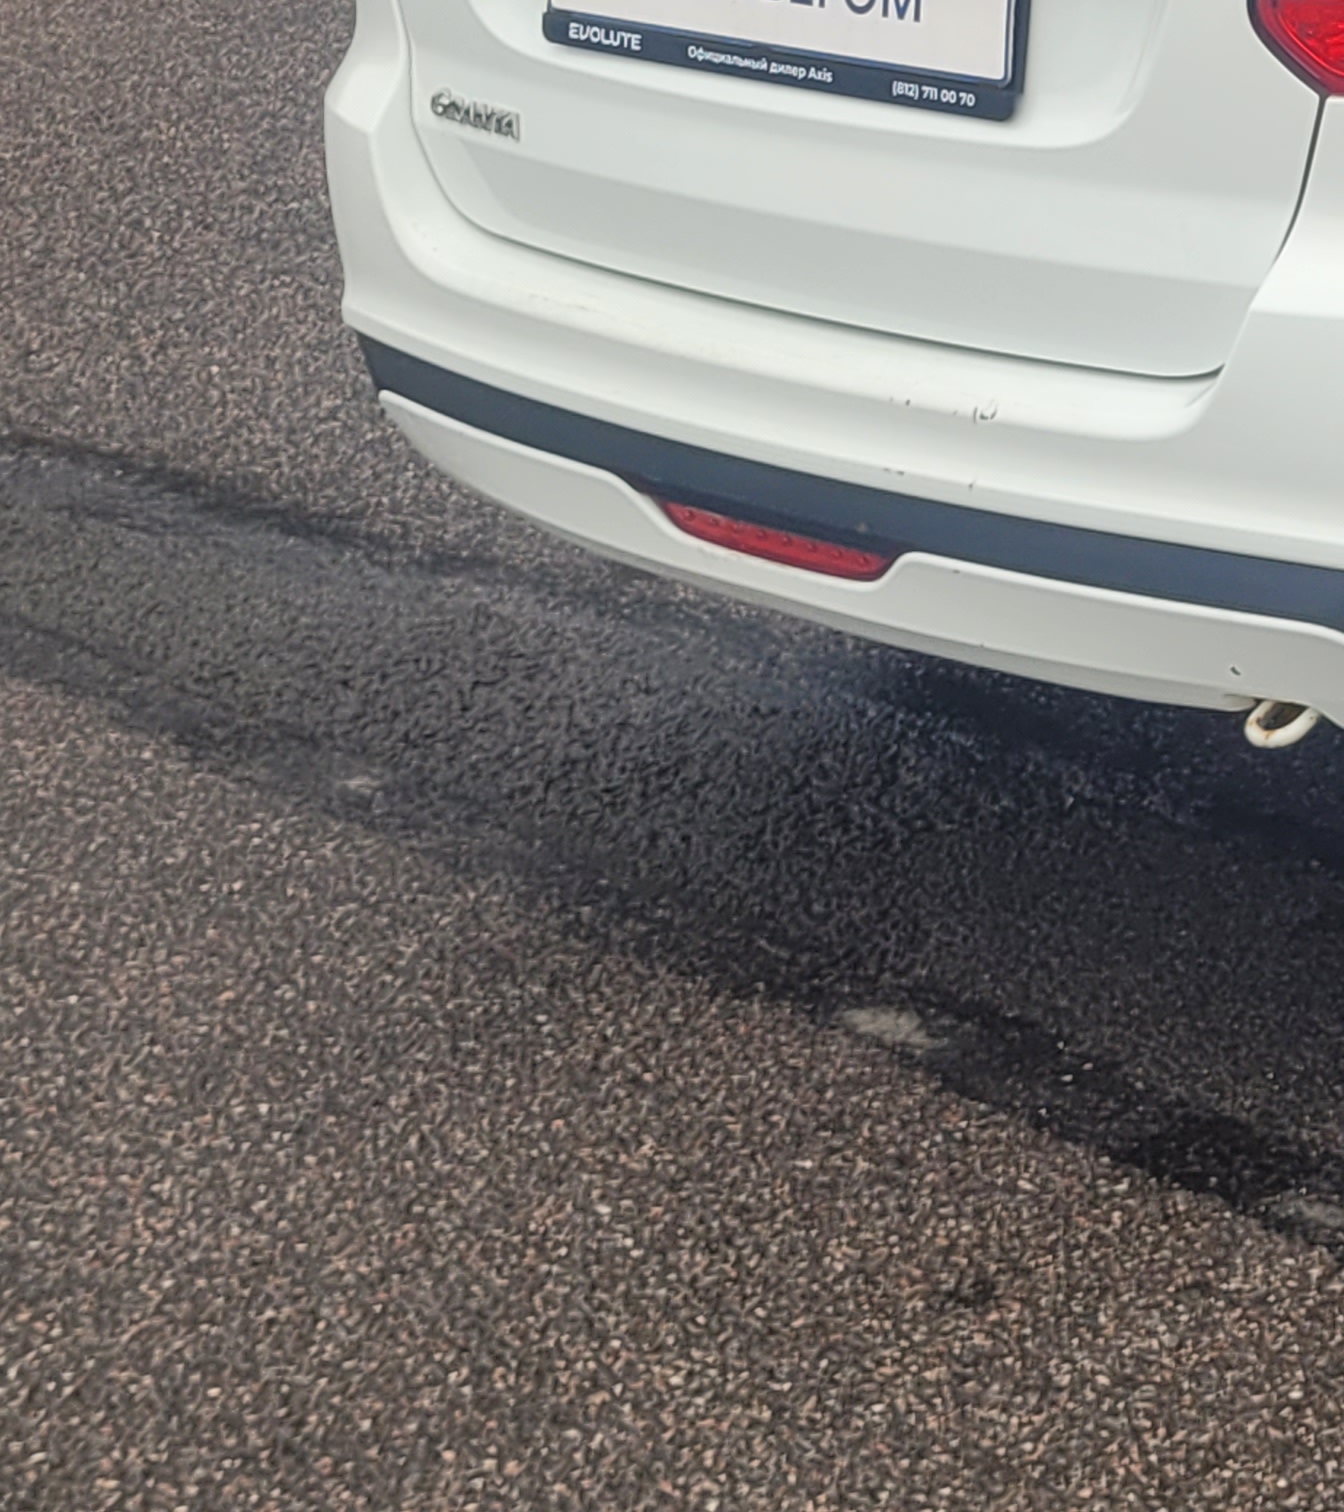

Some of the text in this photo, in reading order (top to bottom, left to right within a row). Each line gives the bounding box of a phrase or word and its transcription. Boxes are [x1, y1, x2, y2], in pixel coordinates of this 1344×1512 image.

[568, 22, 643, 51] EVOLUTE
[687, 45, 834, 83] Официальный дилер Axis
[892, 80, 976, 107] (812) 711 00 70
